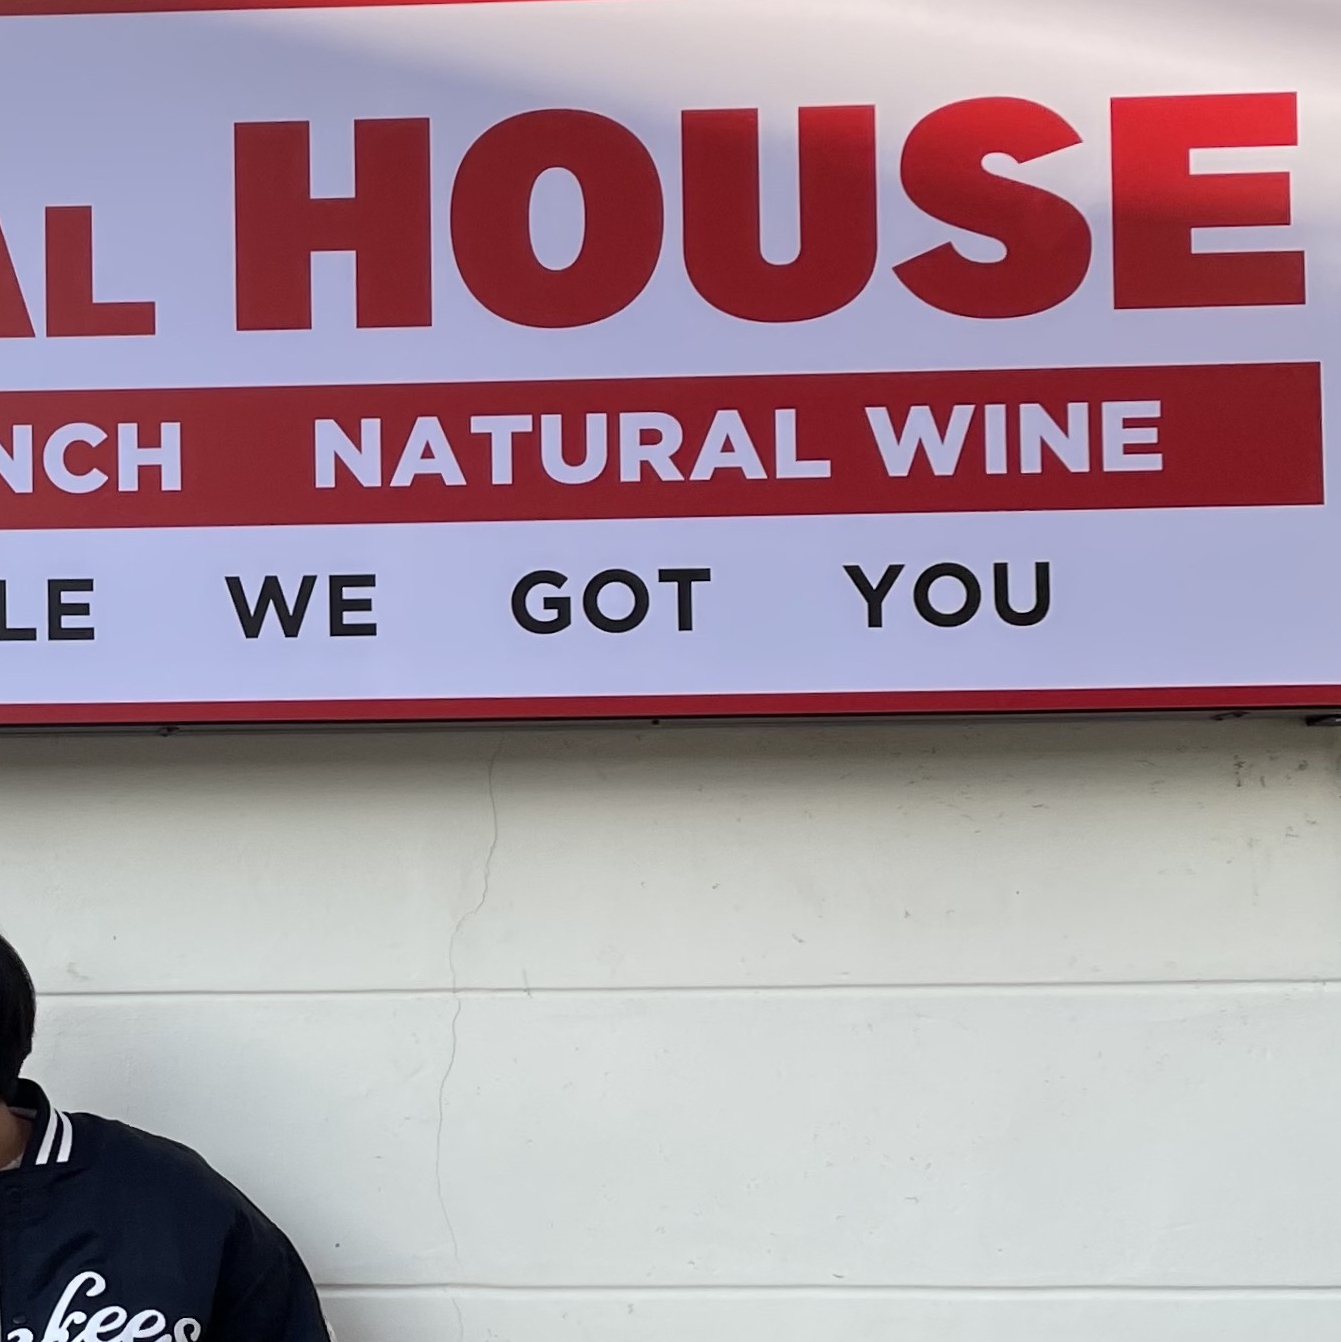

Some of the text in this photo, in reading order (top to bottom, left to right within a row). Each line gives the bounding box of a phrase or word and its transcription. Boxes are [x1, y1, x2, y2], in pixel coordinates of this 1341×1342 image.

[233, 92, 1306, 331] HOUSE
[313, 409, 832, 490] NATURAL
[865, 400, 1164, 478] WINE
[225, 574, 378, 638] WE
[511, 568, 712, 637] GOT
[843, 561, 1052, 629] YOU
